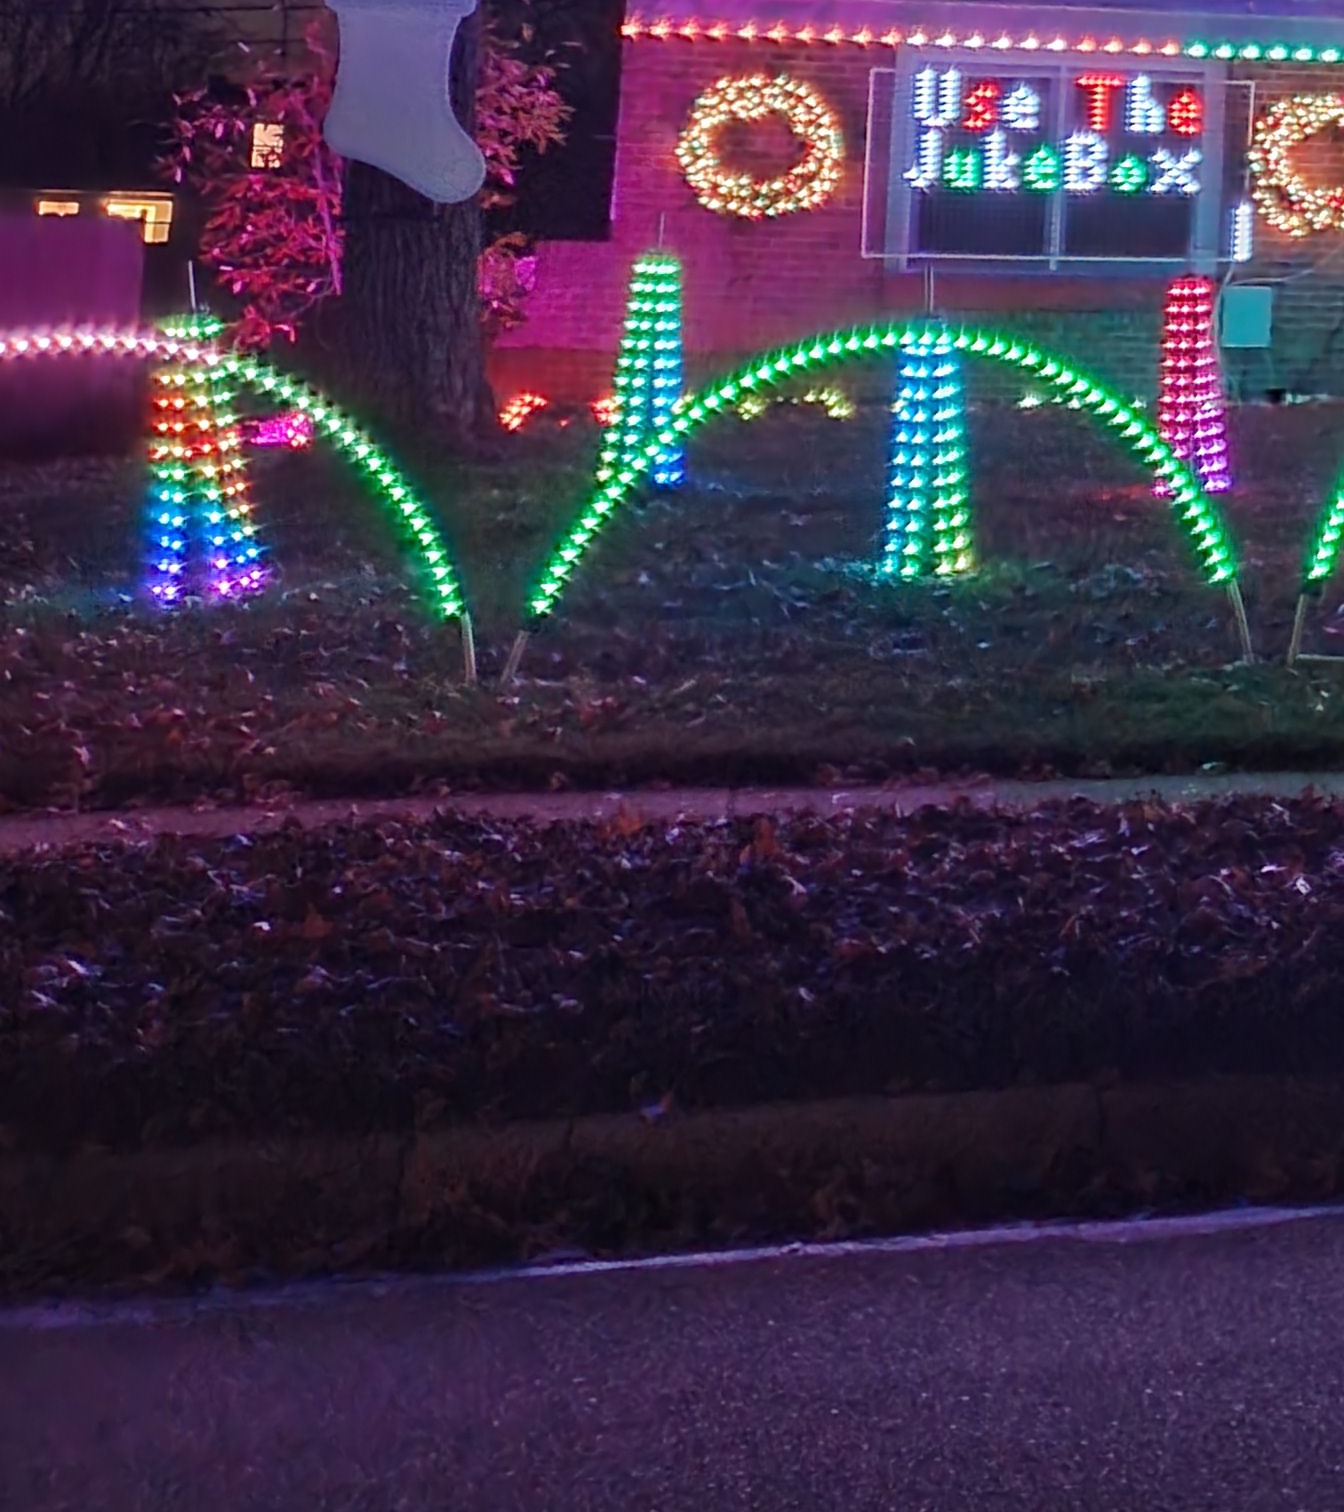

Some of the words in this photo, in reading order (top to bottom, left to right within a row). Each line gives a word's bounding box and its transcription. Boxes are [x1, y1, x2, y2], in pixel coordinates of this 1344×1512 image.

[912, 65, 1042, 129] Use
[1075, 71, 1204, 136] The
[902, 128, 1203, 194] JukeBox
